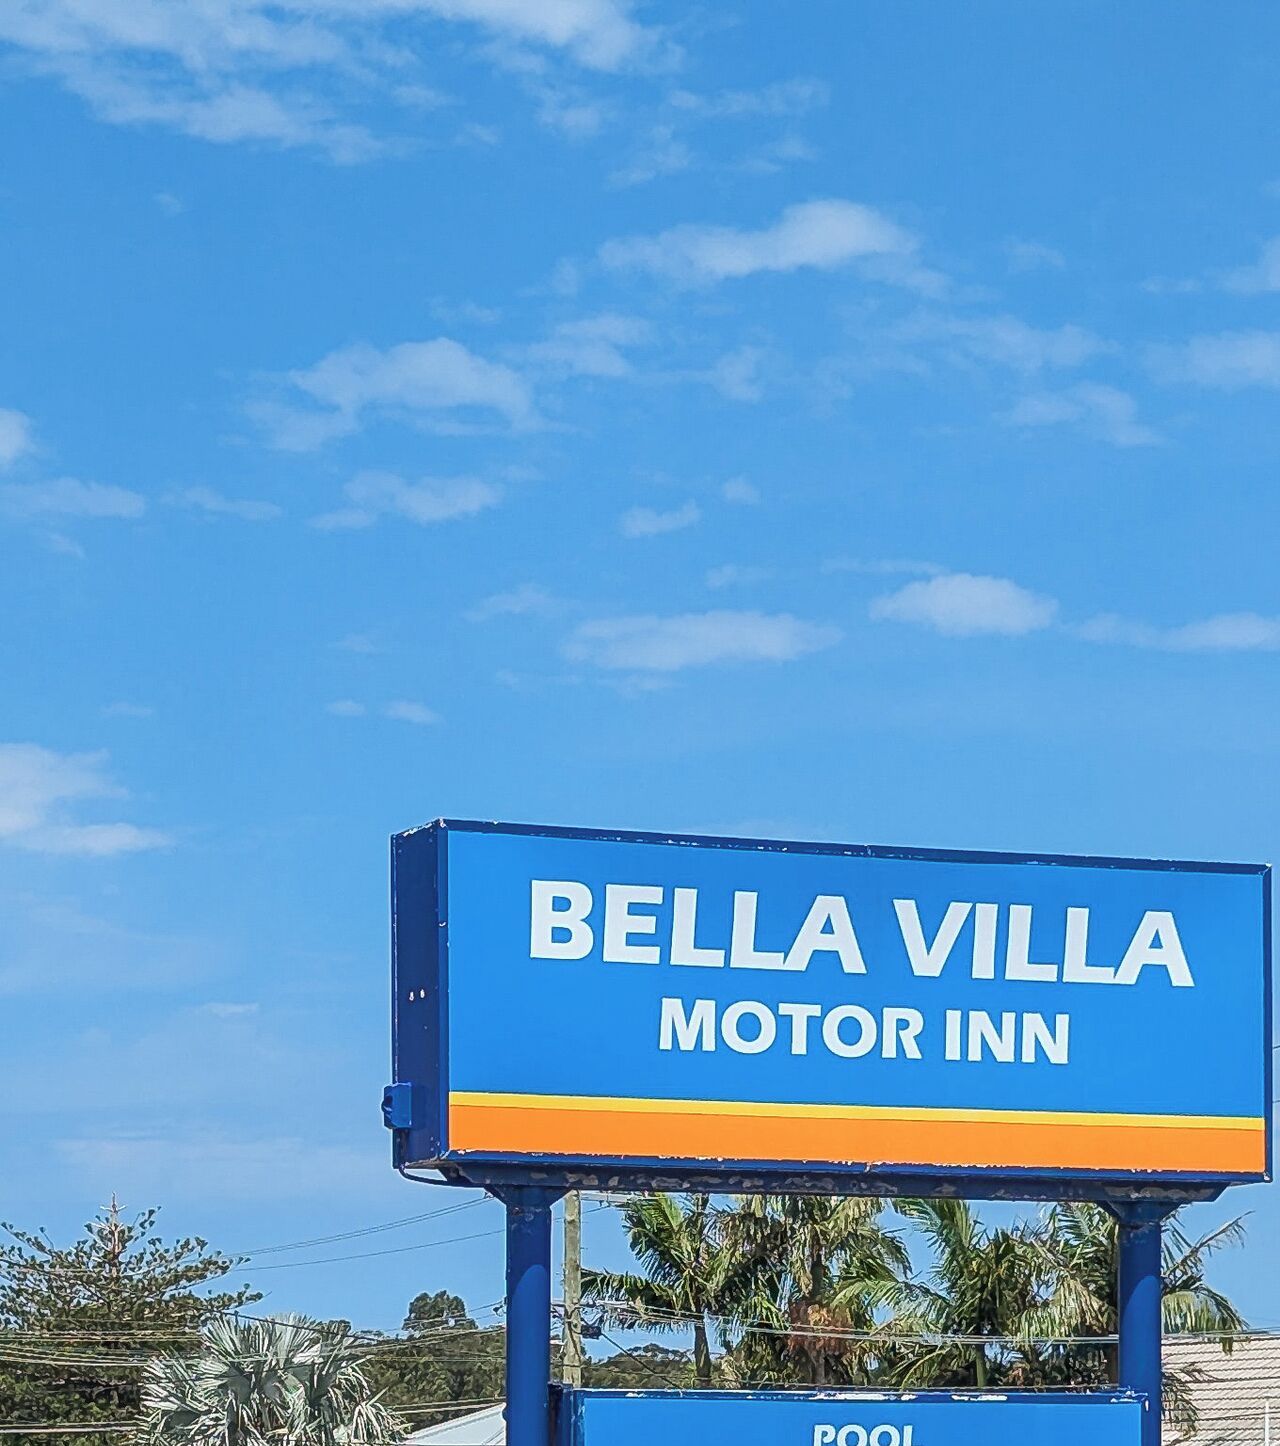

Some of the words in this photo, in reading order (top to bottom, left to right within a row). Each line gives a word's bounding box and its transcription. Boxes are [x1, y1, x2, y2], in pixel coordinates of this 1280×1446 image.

[530, 878, 868, 975] BELLA
[892, 898, 1196, 988] VILLA
[658, 996, 924, 1061] MOTOR
[944, 1009, 1069, 1064] INN
